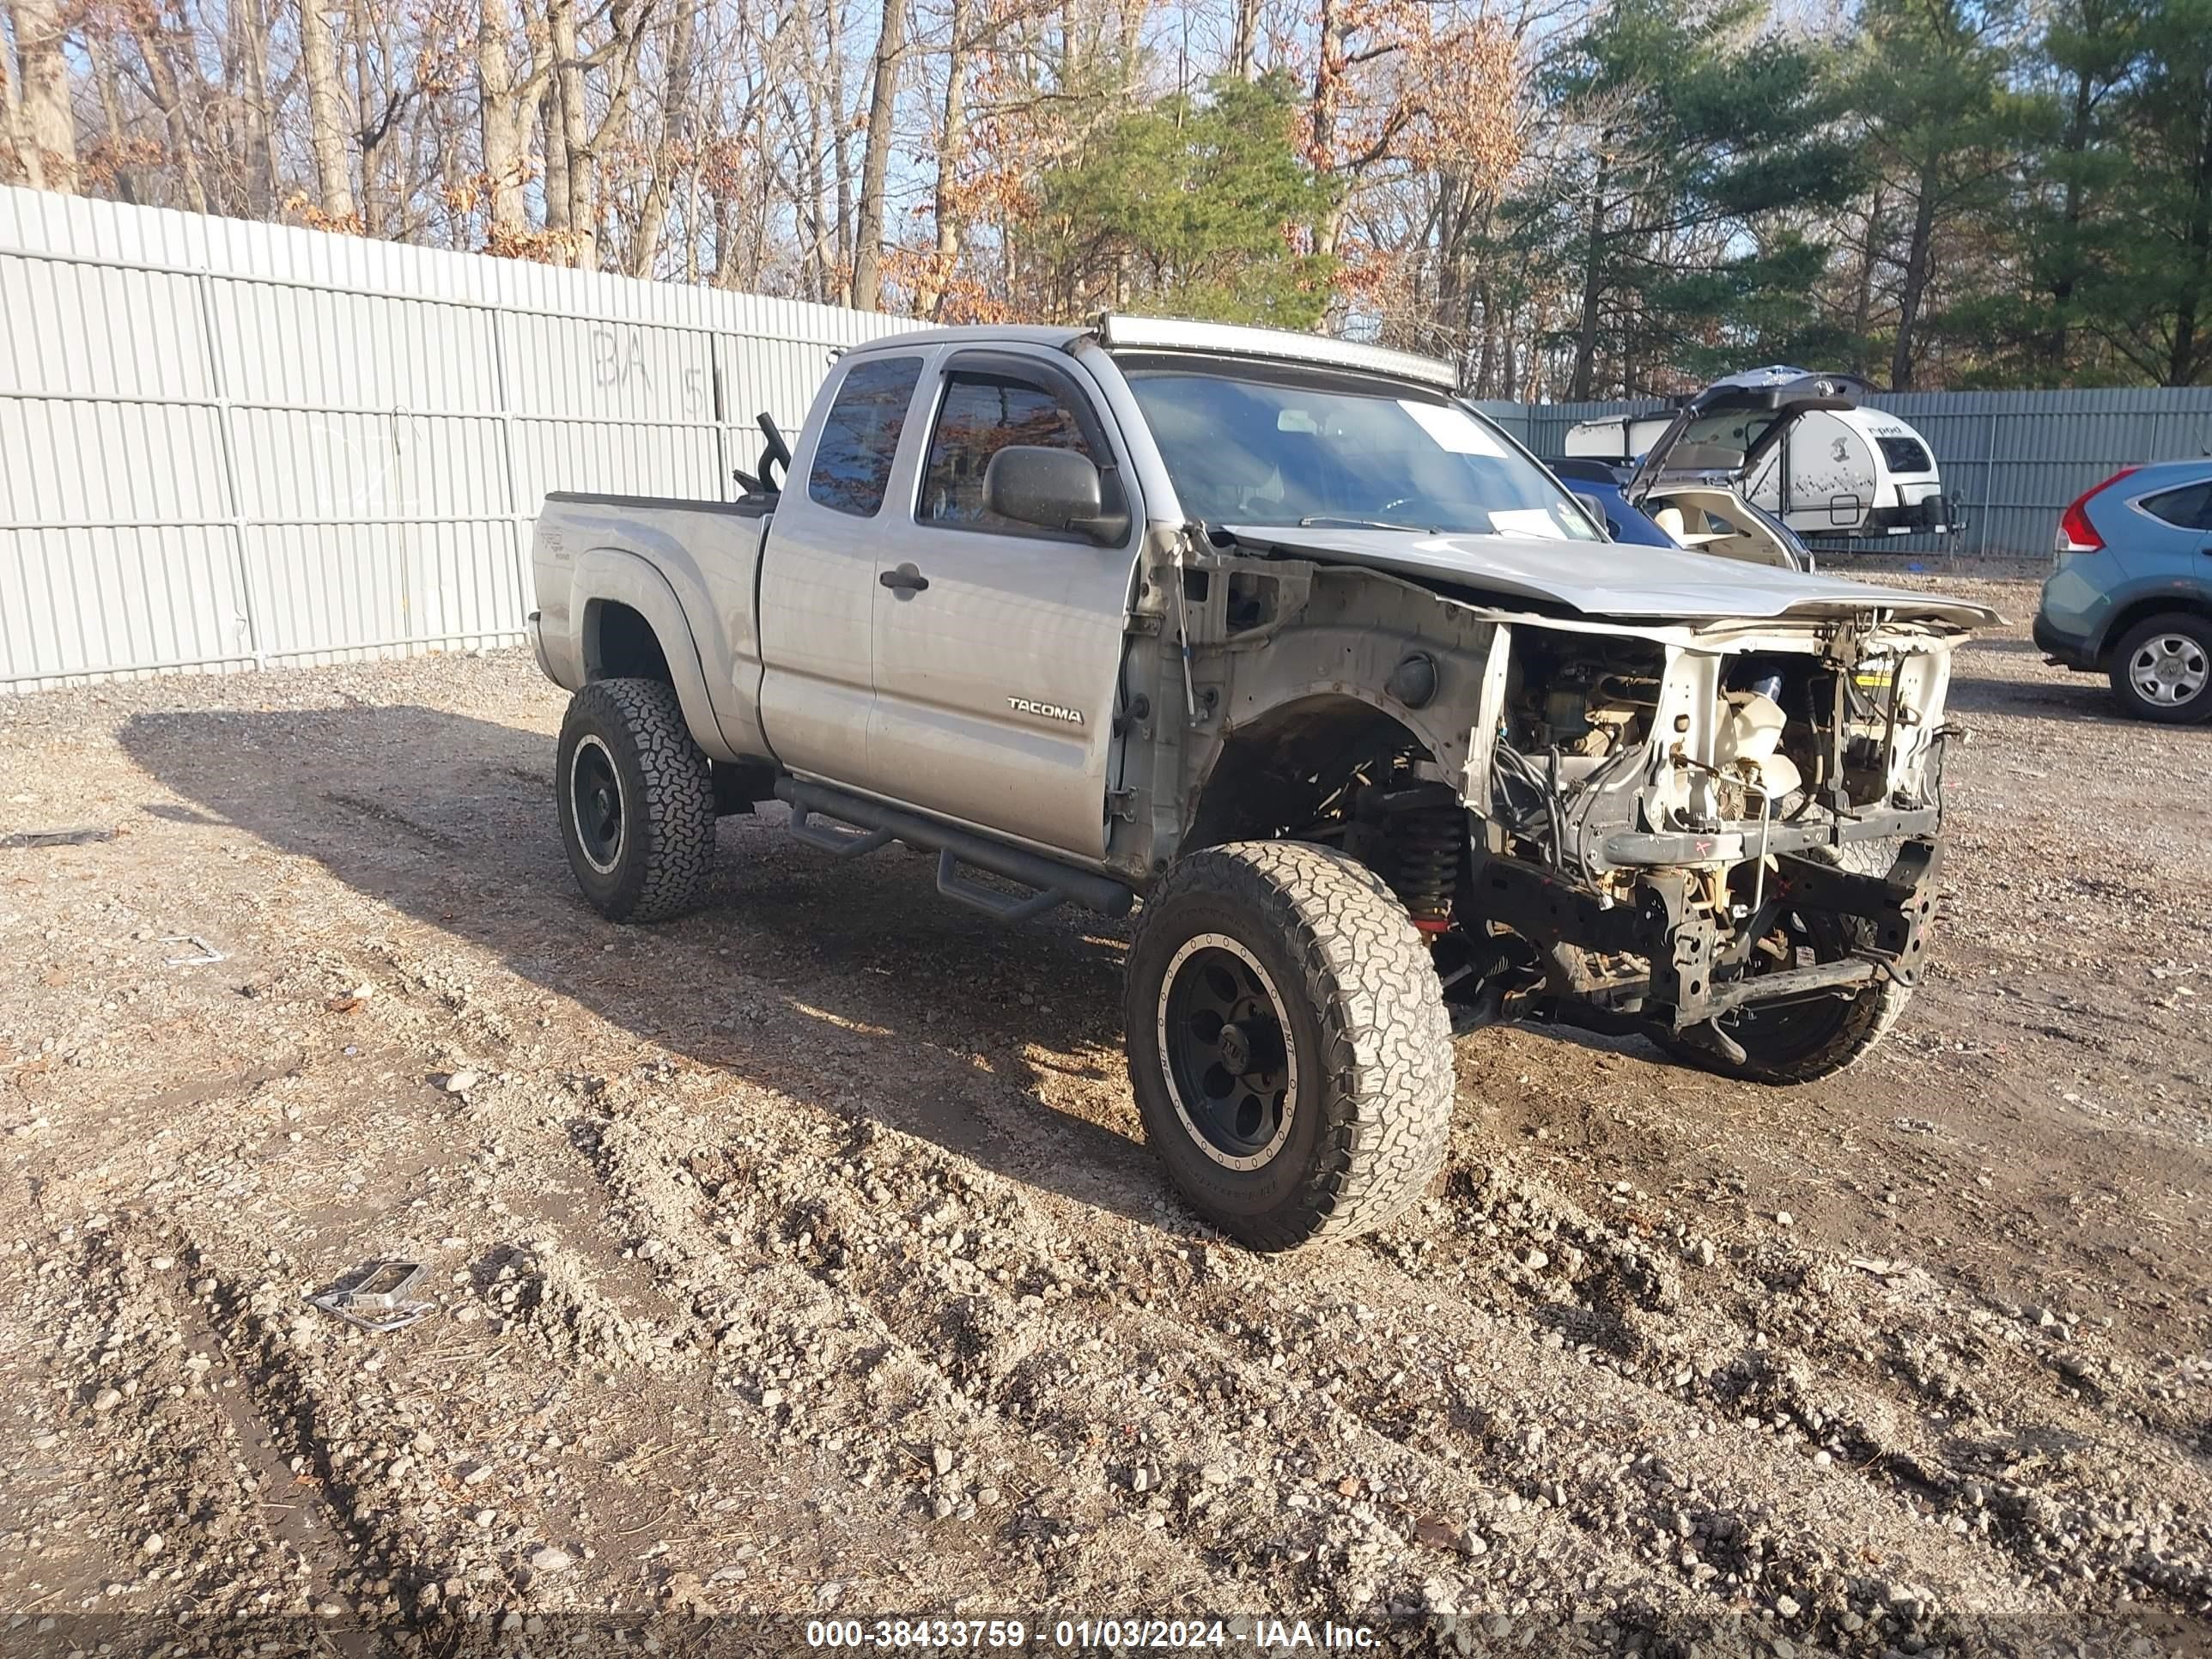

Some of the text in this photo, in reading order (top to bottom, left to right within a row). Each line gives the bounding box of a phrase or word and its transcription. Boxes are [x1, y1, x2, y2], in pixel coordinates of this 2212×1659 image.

[592, 329, 704, 414] BA 5
[1007, 696, 1085, 725] TACOMA
